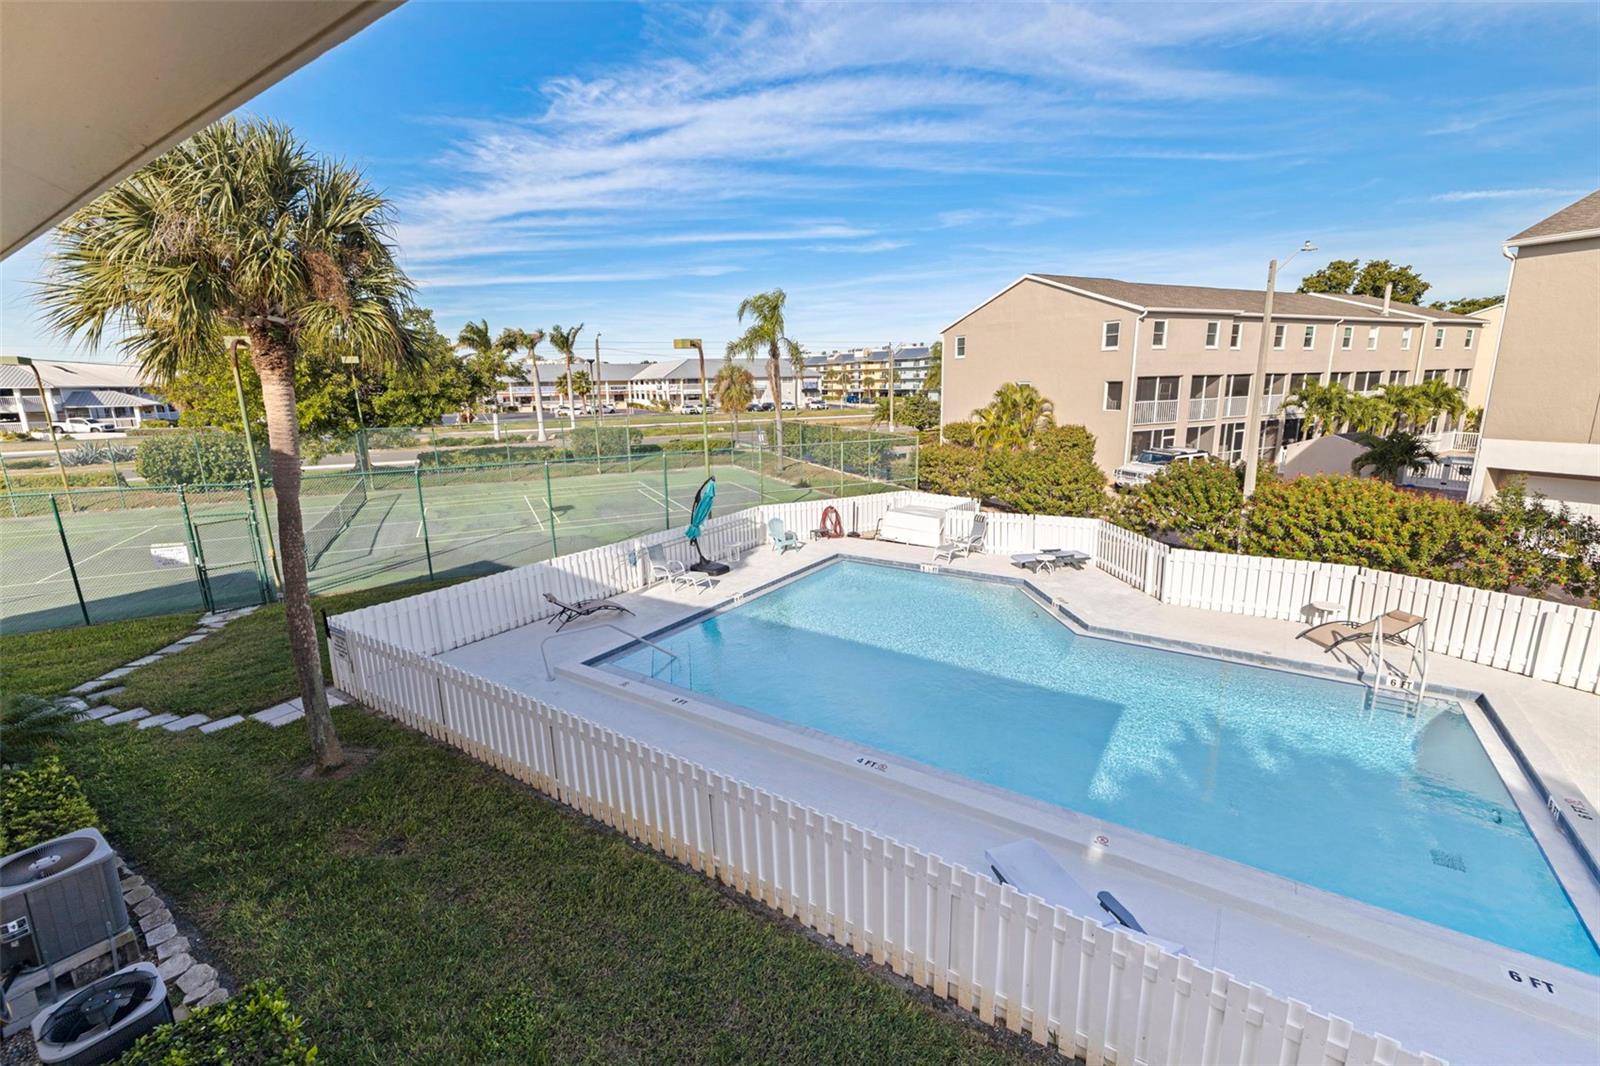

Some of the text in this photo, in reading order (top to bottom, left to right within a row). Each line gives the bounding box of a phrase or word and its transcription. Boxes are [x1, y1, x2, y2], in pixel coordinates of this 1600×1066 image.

[1390, 679, 1413, 689] 6 FT
[864, 760, 877, 768] FT
[1508, 970, 1554, 994] 6 FT
